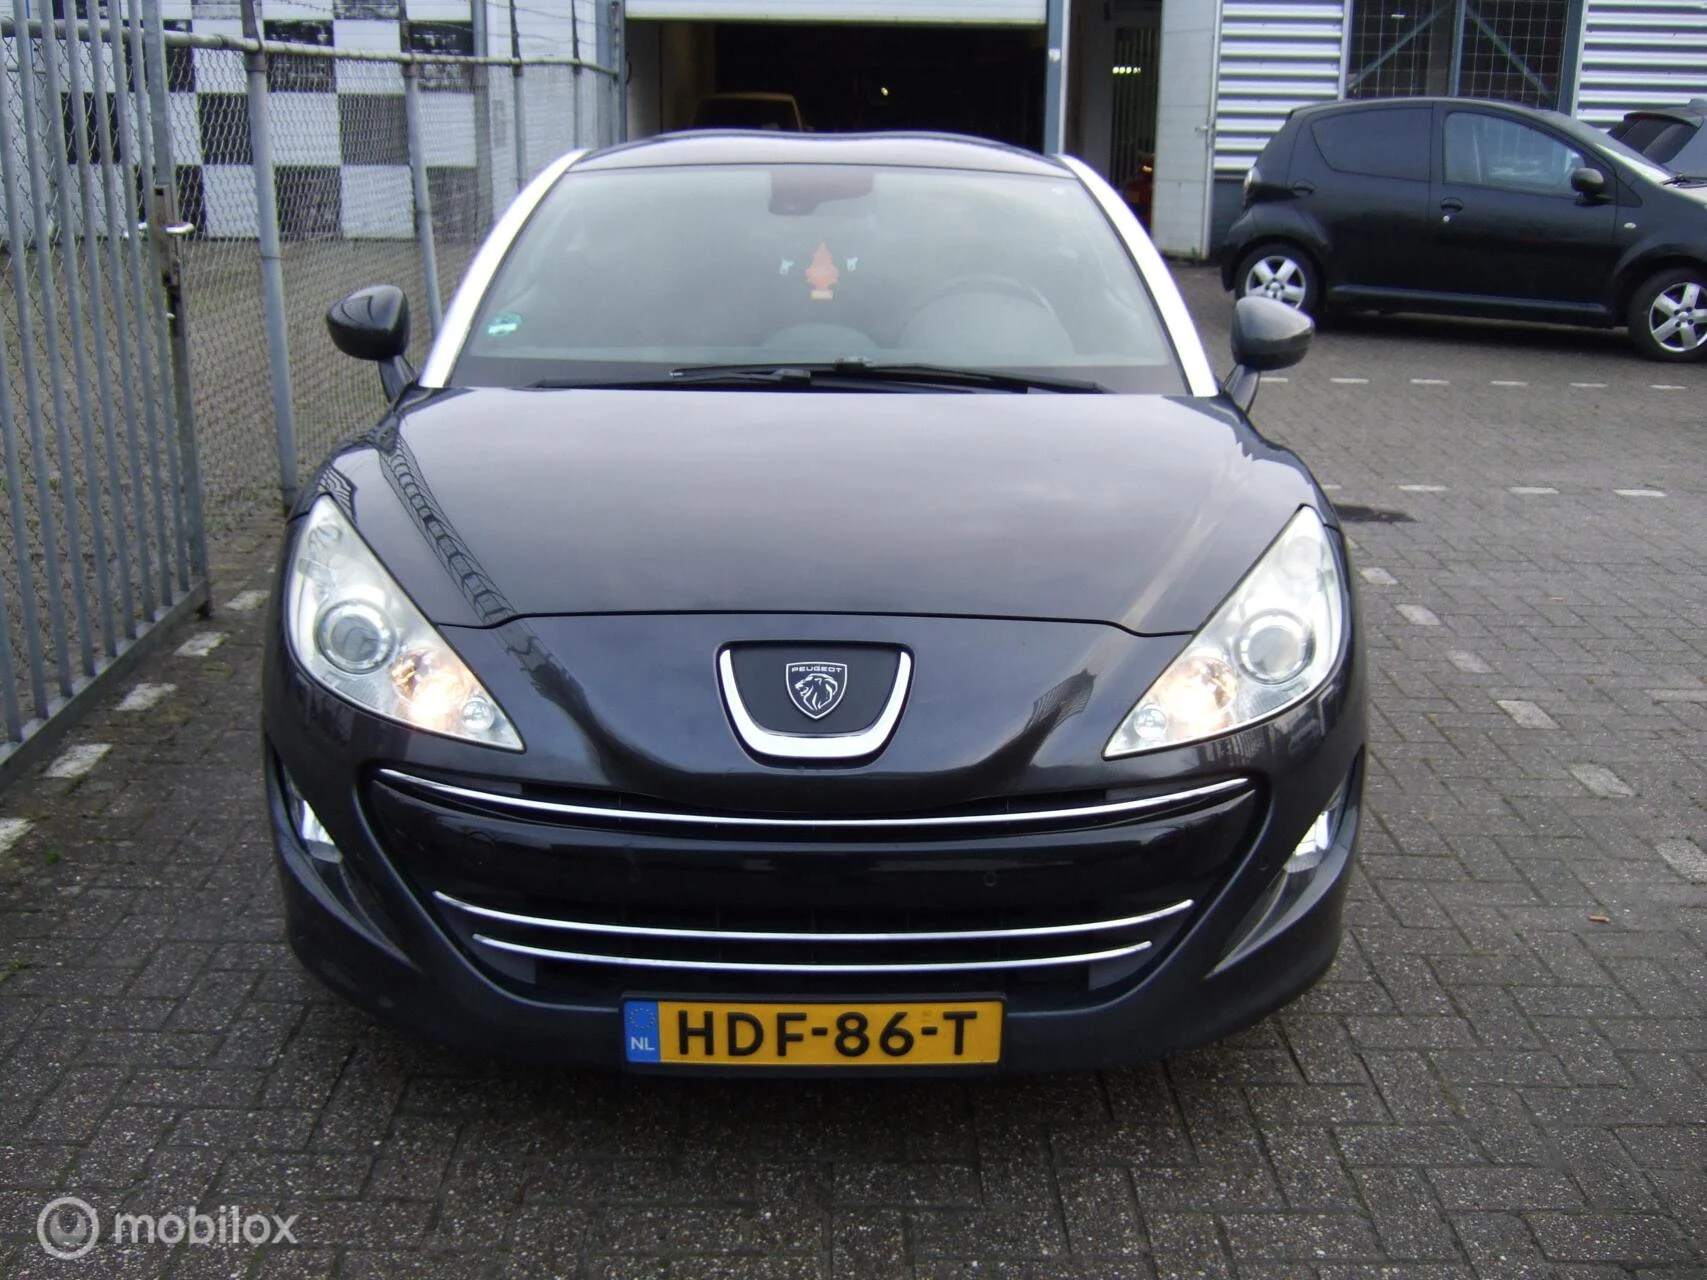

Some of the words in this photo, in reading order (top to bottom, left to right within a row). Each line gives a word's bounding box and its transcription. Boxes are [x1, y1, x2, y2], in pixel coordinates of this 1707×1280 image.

[791, 665, 843, 673] PEUGEOT
[677, 1009, 978, 1057] HDF-86-T
[630, 1036, 656, 1051] NL
